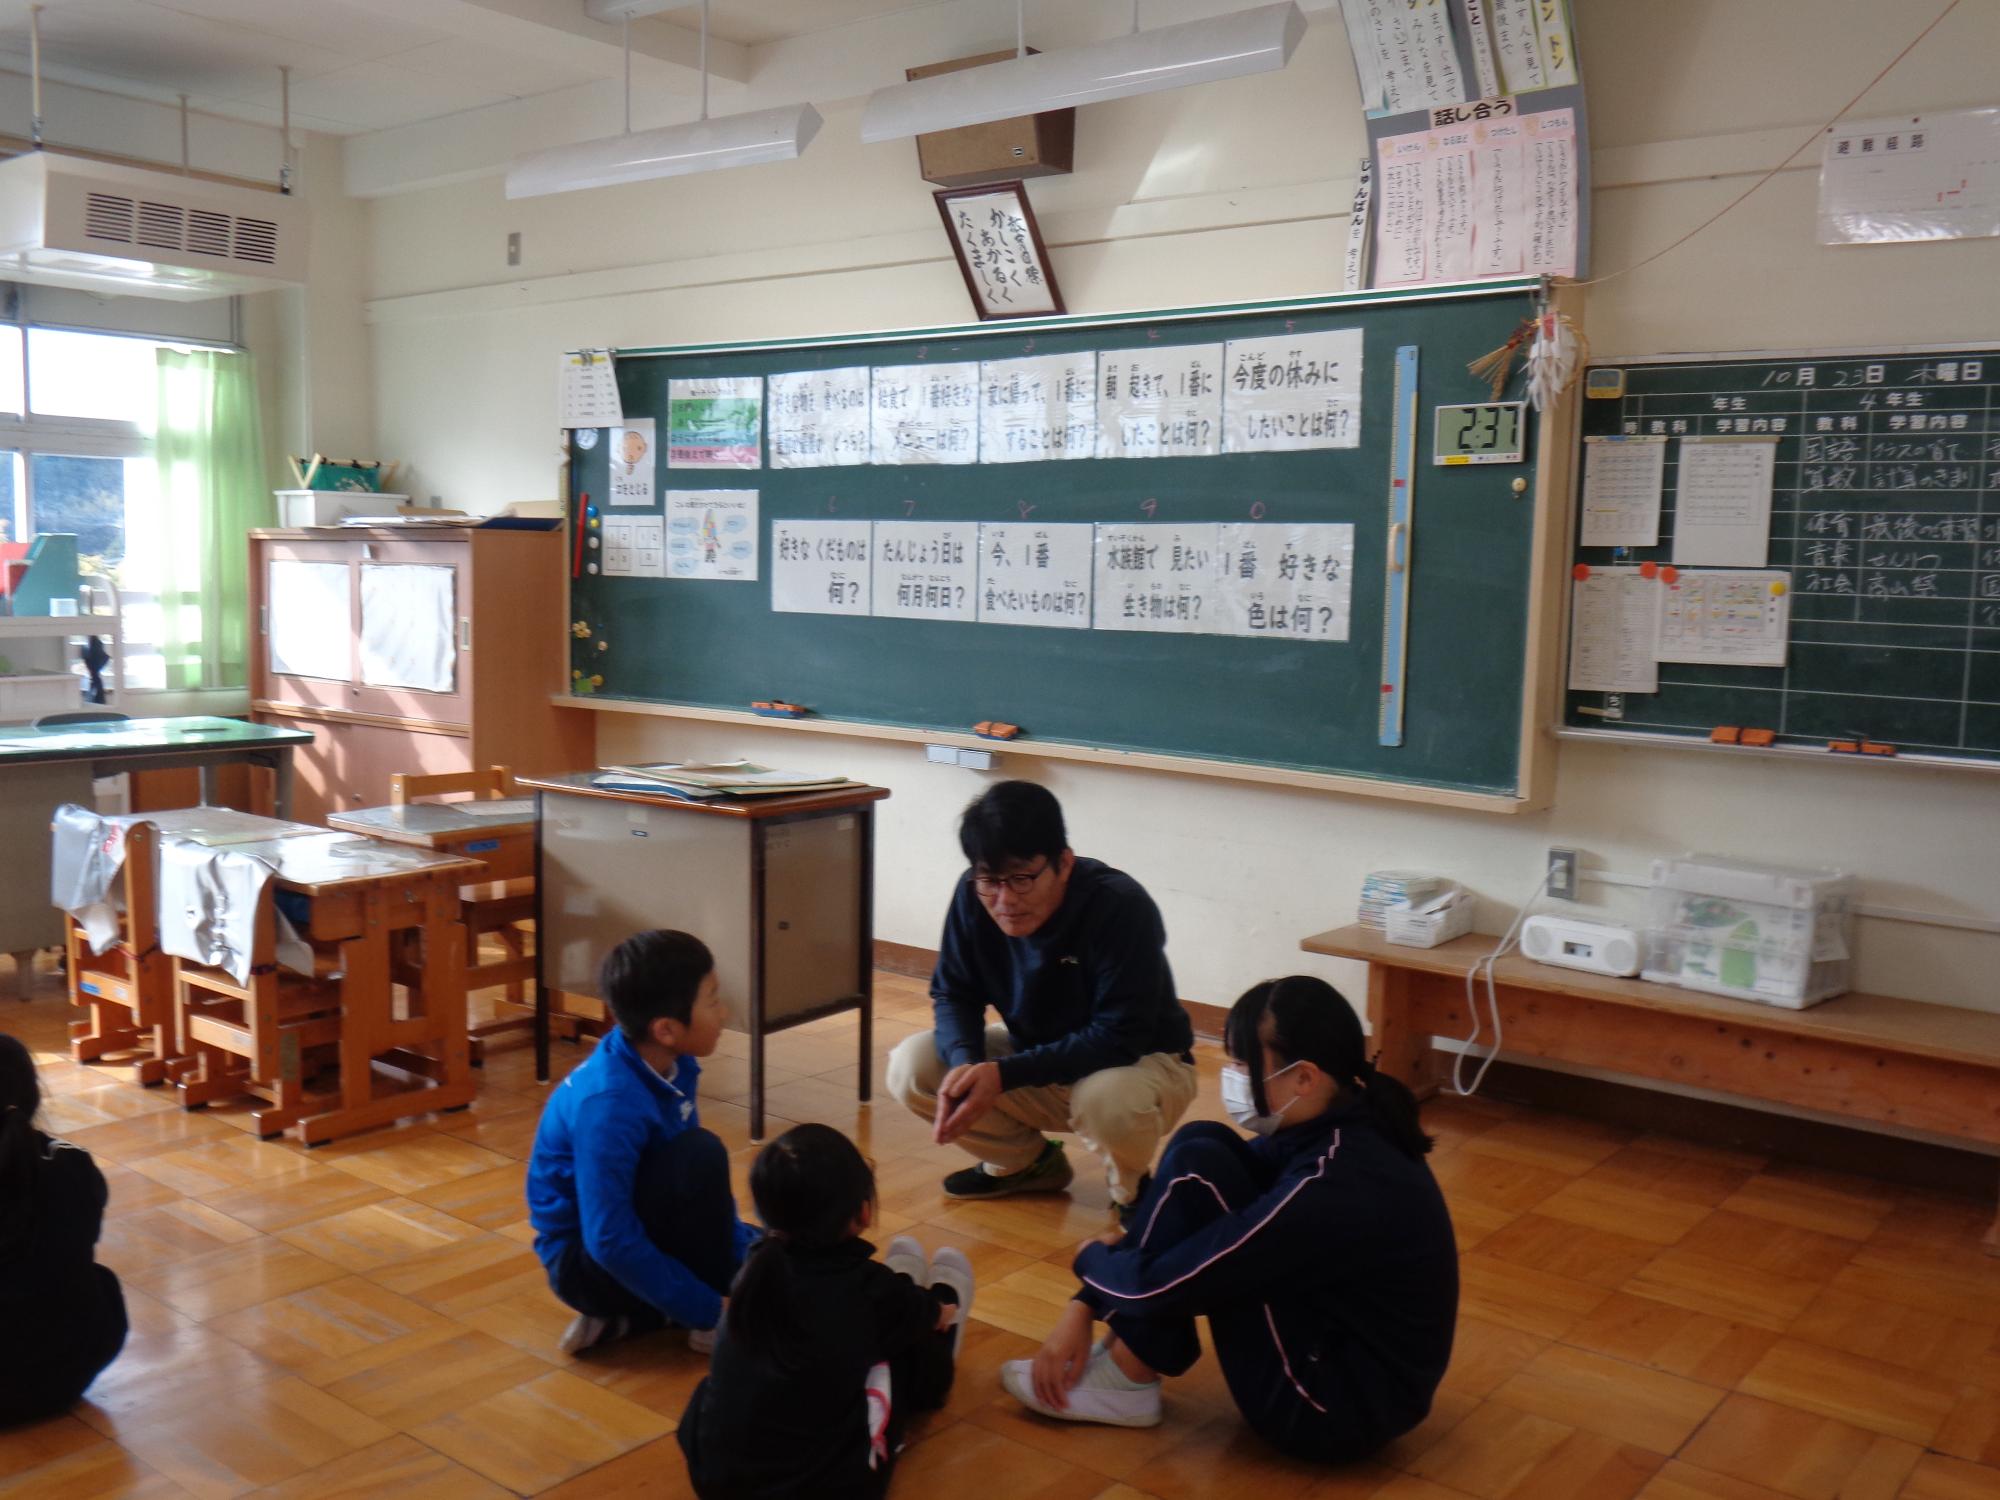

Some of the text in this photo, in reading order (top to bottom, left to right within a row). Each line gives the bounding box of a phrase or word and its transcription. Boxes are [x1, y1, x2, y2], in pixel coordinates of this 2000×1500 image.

[1433, 99, 1513, 127] 話し合う
[958, 211, 999, 304] たくましく
[991, 208, 1022, 287] かしこく
[981, 229, 1013, 303] あかるく
[1233, 359, 1340, 391] 今度の休みに
[1248, 408, 1350, 440] したいことは何？
[1716, 417, 1789, 434] 学習内容
[1816, 415, 1858, 432] 教科
[1889, 413, 1970, 430] 学習内容
[1804, 511, 1853, 538] 体育
[883, 538, 965, 565] たんじょう日は
[1107, 546, 1211, 573] 水族館で 見たい
[1804, 541, 1853, 568] 音楽
[1277, 553, 1342, 582] 好きな
[828, 581, 861, 605] 何？
[896, 582, 966, 610] 何月何日？
[1805, 570, 1856, 595] 社会
[985, 590, 1087, 616] 食べたいものは何？
[1122, 593, 1203, 621] 生き物は何？
[1246, 602, 1334, 634] 色は何？
